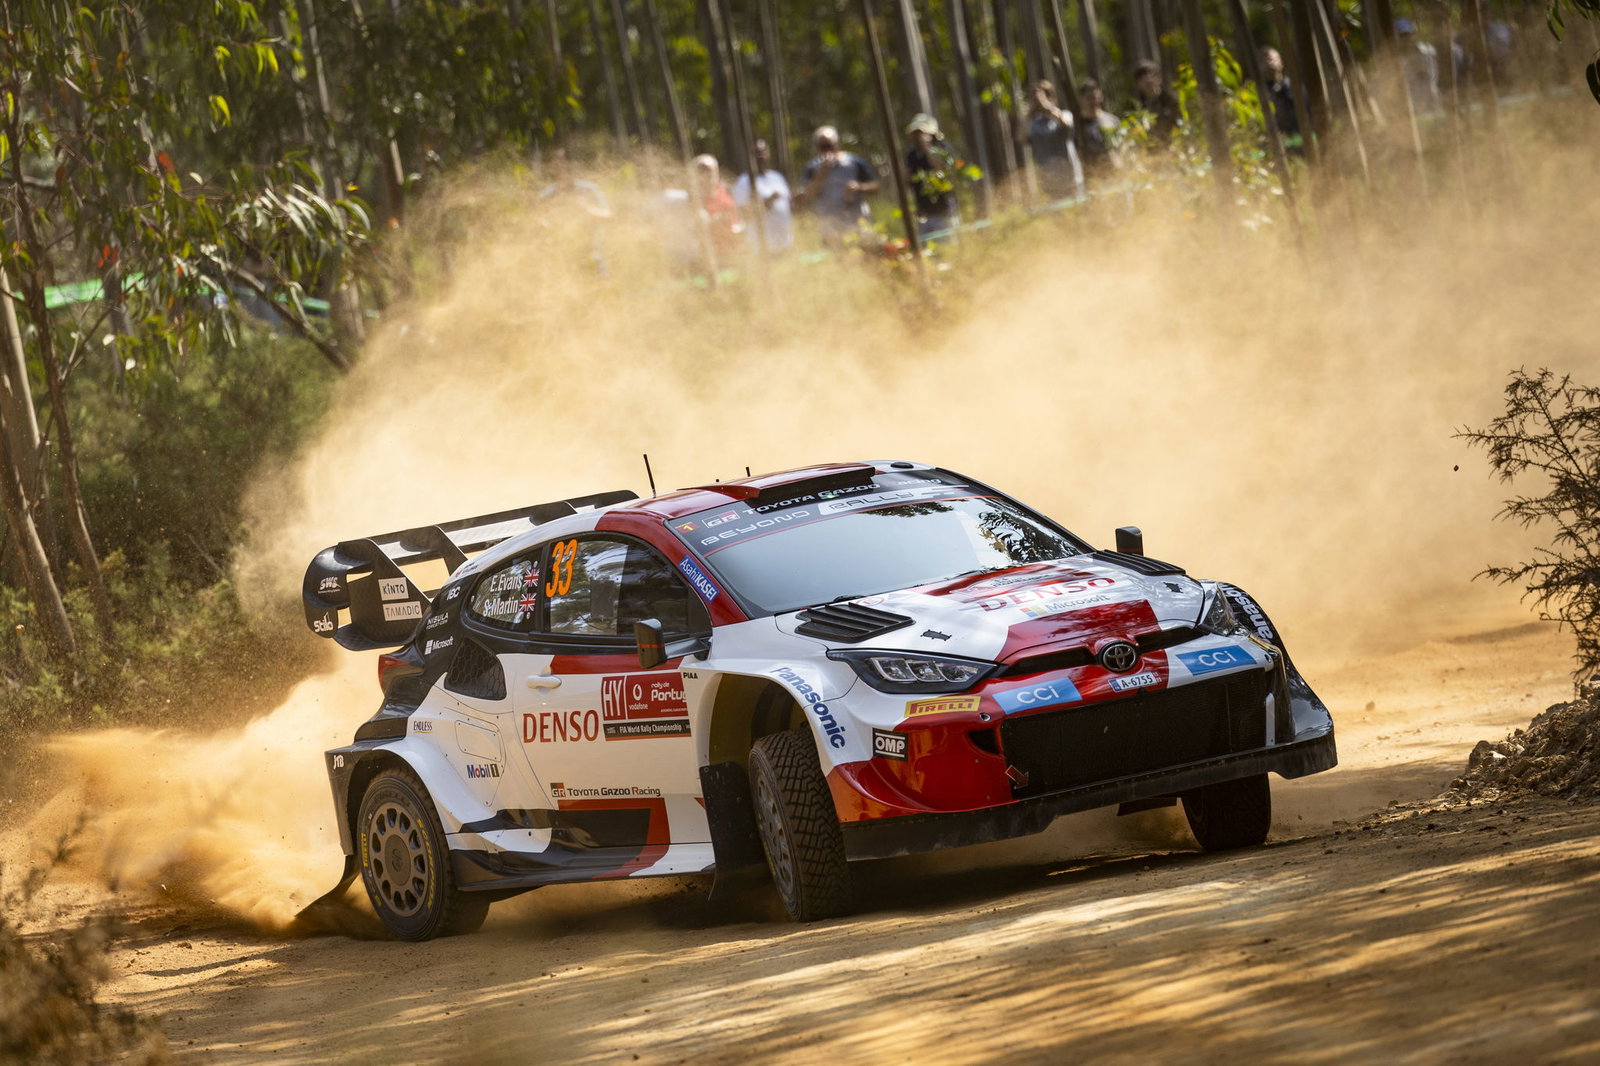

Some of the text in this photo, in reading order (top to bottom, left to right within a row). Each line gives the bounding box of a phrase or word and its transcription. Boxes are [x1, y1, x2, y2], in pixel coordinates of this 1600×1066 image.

[743, 492, 815, 515] TOYOTA
[818, 483, 881, 500] GAZOO
[701, 492, 913, 545] BEYOND RALLY
[545, 539, 578, 598] 33
[977, 578, 1115, 612] DENSO
[1045, 594, 1111, 611] Microsoft
[385, 606, 421, 617] TAMADIC
[433, 636, 453, 650] Microsoft
[1121, 675, 1153, 689] A-6755
[603, 680, 622, 717] HY
[909, 698, 974, 715] PIRELLI
[770, 667, 846, 749] Panasonic
[413, 721, 433, 731] ENDLESS
[523, 710, 599, 743] DENSO
[619, 726, 628, 734] FIA
[628, 724, 640, 733] World
[640, 724, 652, 733] Rally
[652, 723, 682, 733] Championship
[875, 737, 906, 754] OMP
[467, 764, 491, 779] Mobil
[552, 786, 661, 797] GR TOYOTA GAZOO Racing
